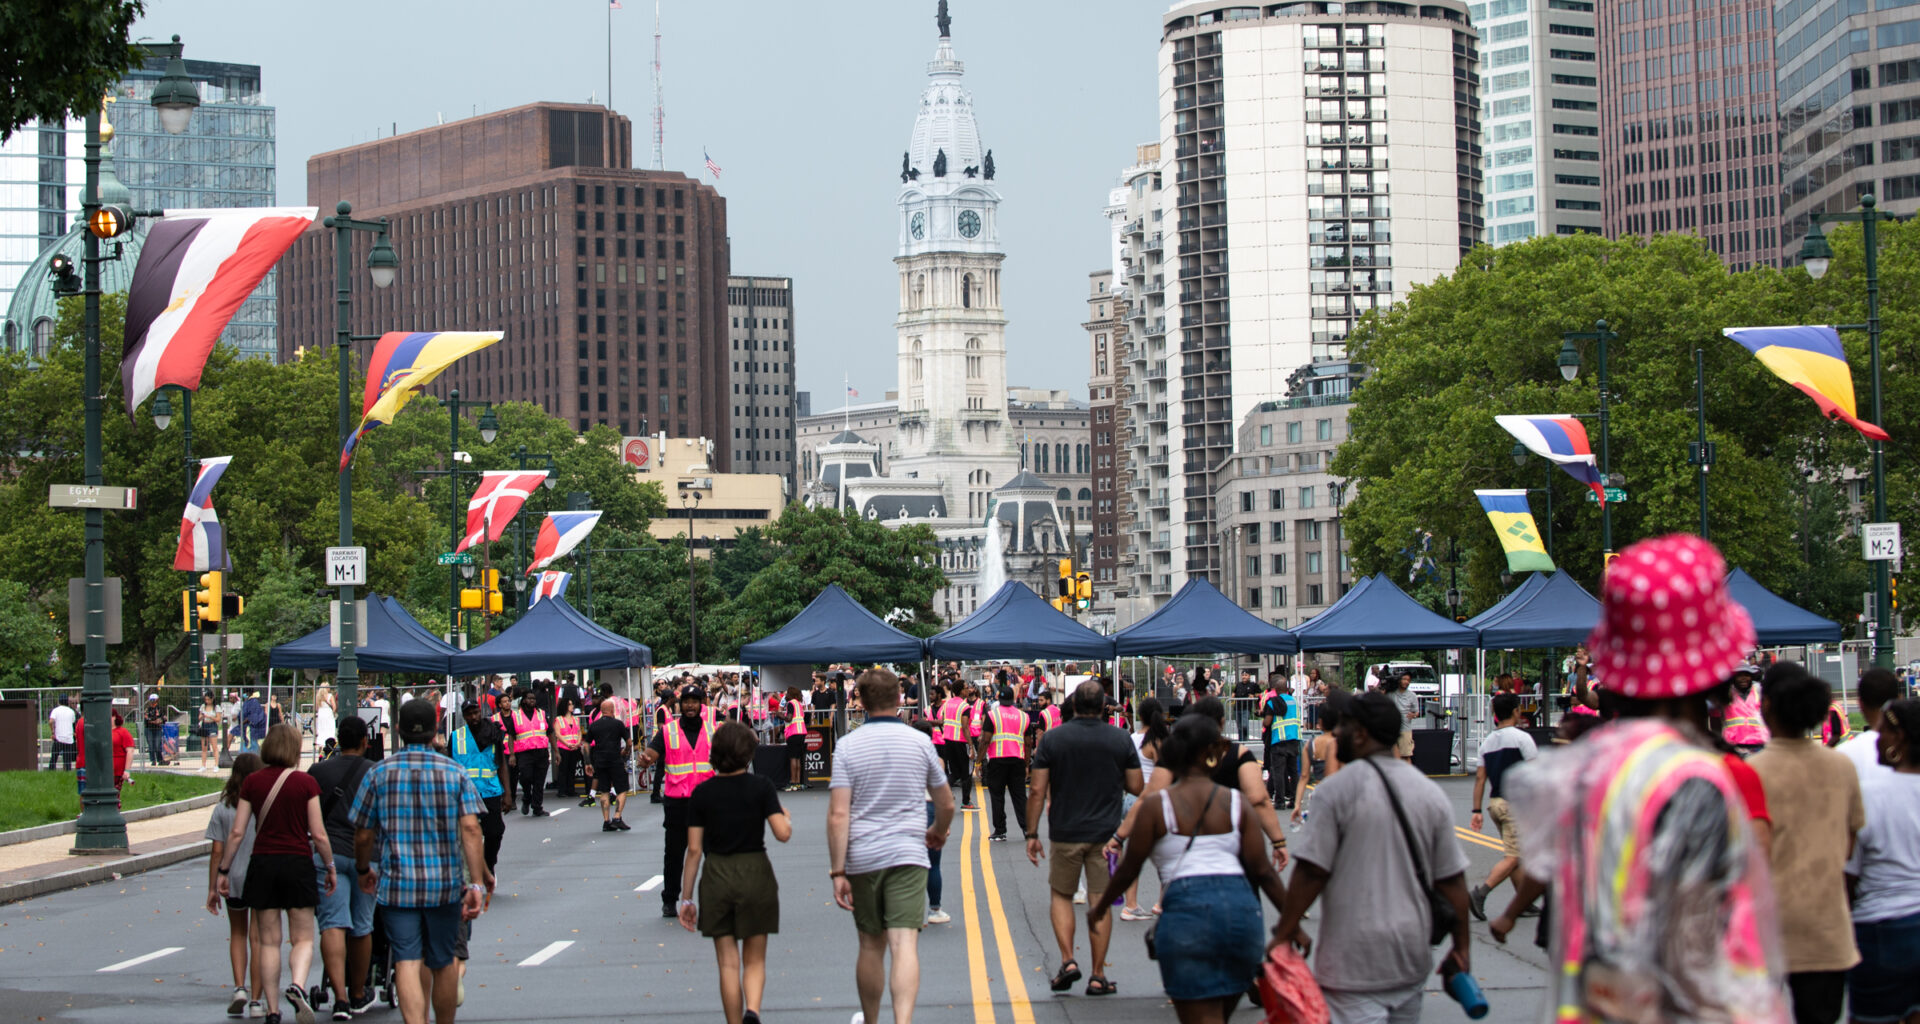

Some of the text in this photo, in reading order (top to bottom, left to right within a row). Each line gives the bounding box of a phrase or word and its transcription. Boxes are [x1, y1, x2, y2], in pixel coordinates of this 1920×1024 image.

[69, 486, 101, 496] EGYPT
[1617, 492, 1628, 501] St
[1871, 539, 1895, 556] M-2
[463, 556, 472, 564] St
[335, 564, 356, 581] M-1
[805, 752, 821, 761] NO
